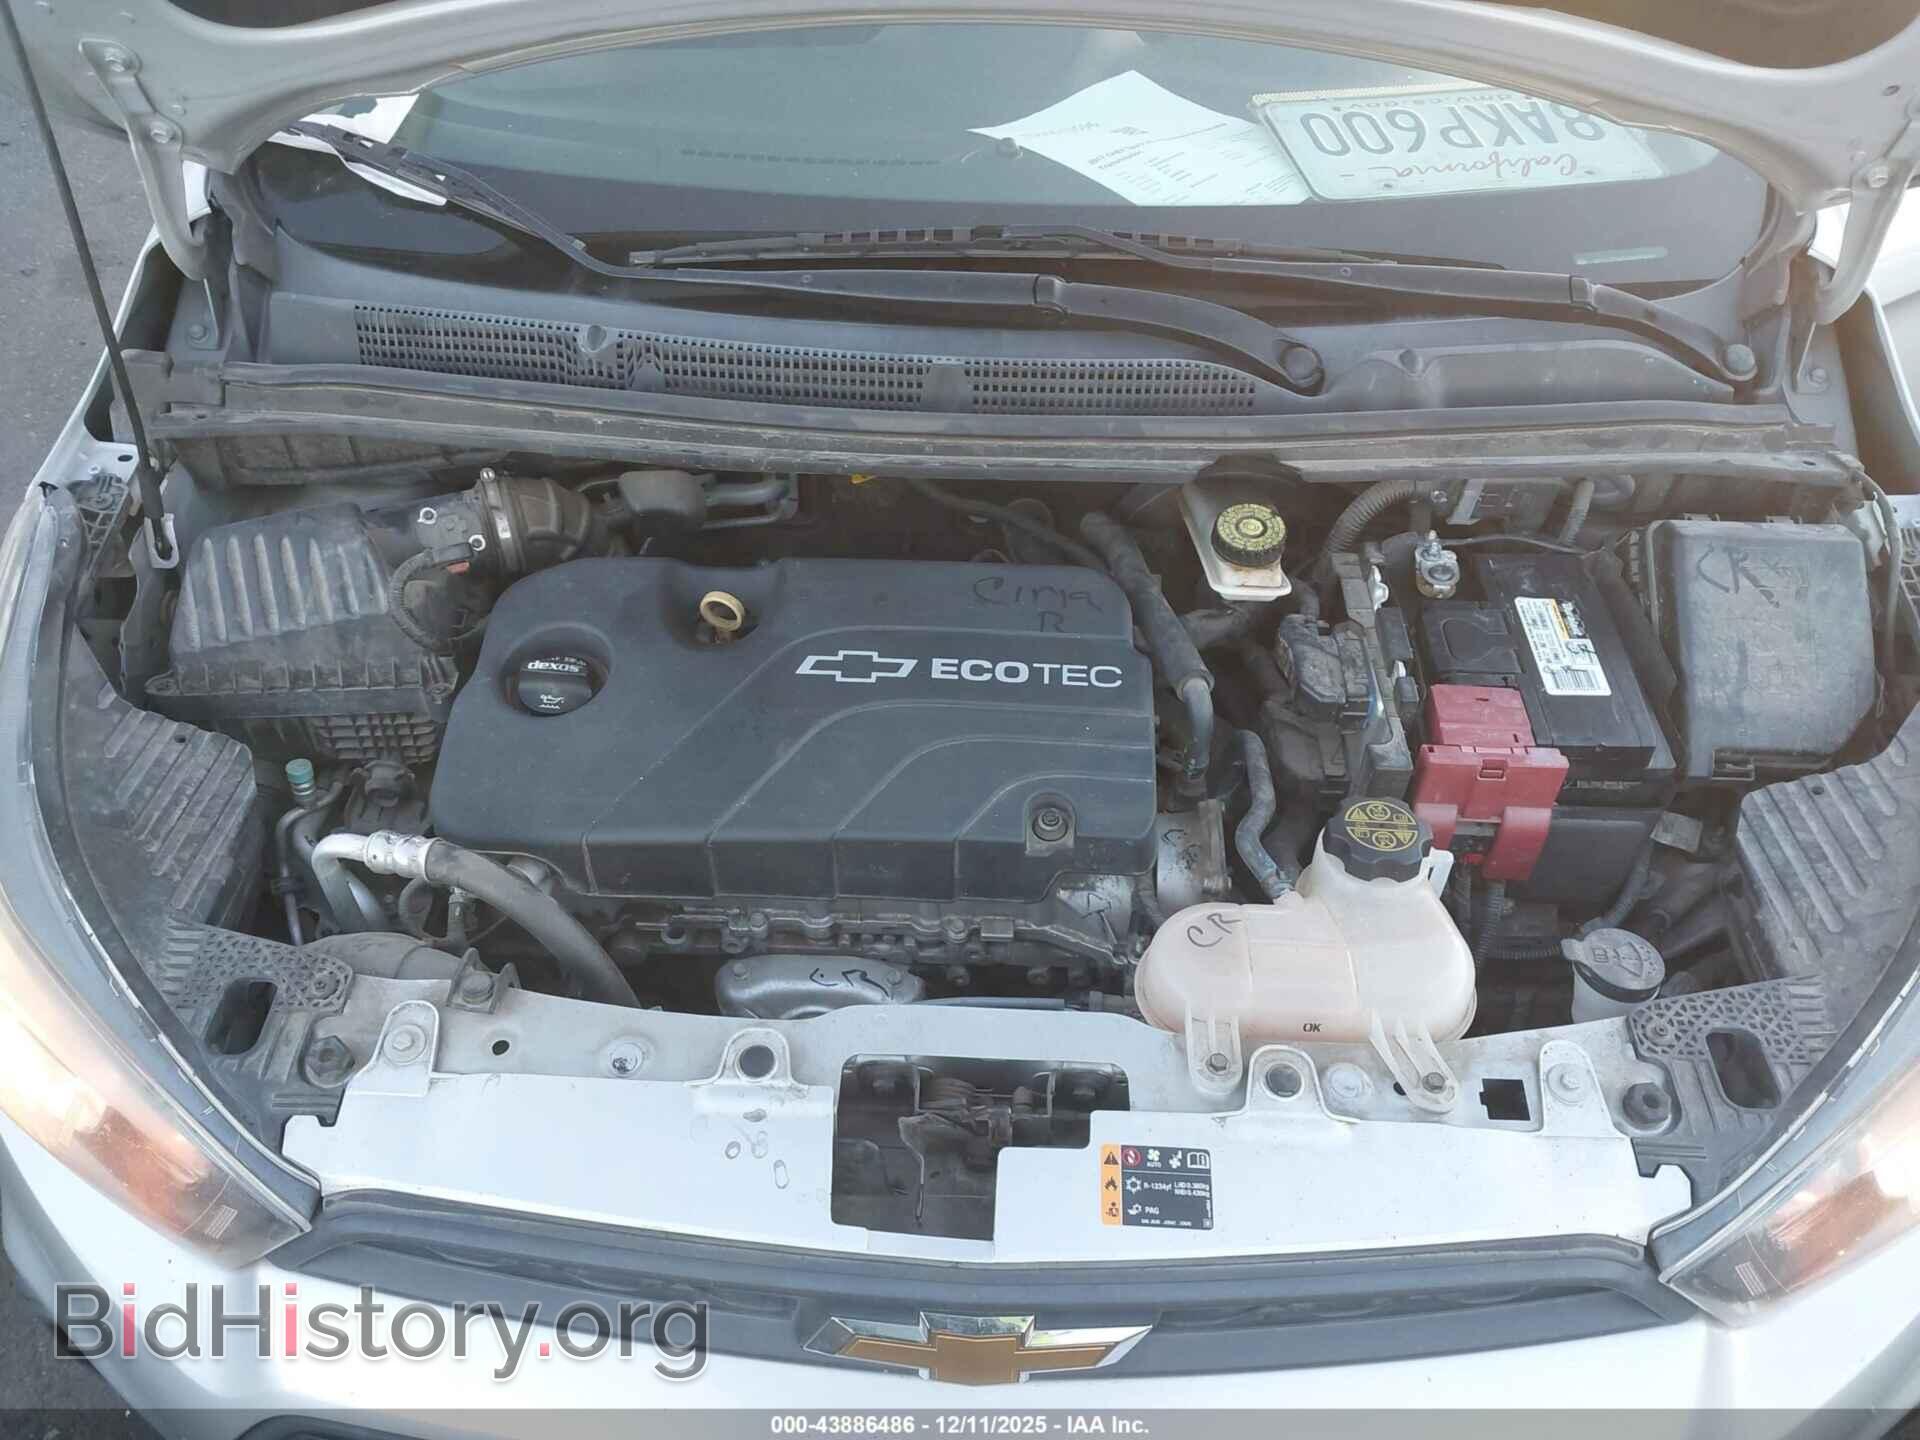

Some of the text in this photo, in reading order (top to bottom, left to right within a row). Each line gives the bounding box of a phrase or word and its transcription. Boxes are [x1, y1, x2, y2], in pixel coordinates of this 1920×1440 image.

[1367, 150, 1578, 179] California
[527, 659, 580, 673] dexos
[931, 658, 1123, 688] ECOTEC
[1187, 913, 1242, 948] CR
[1302, 1022, 1323, 1033] OK
